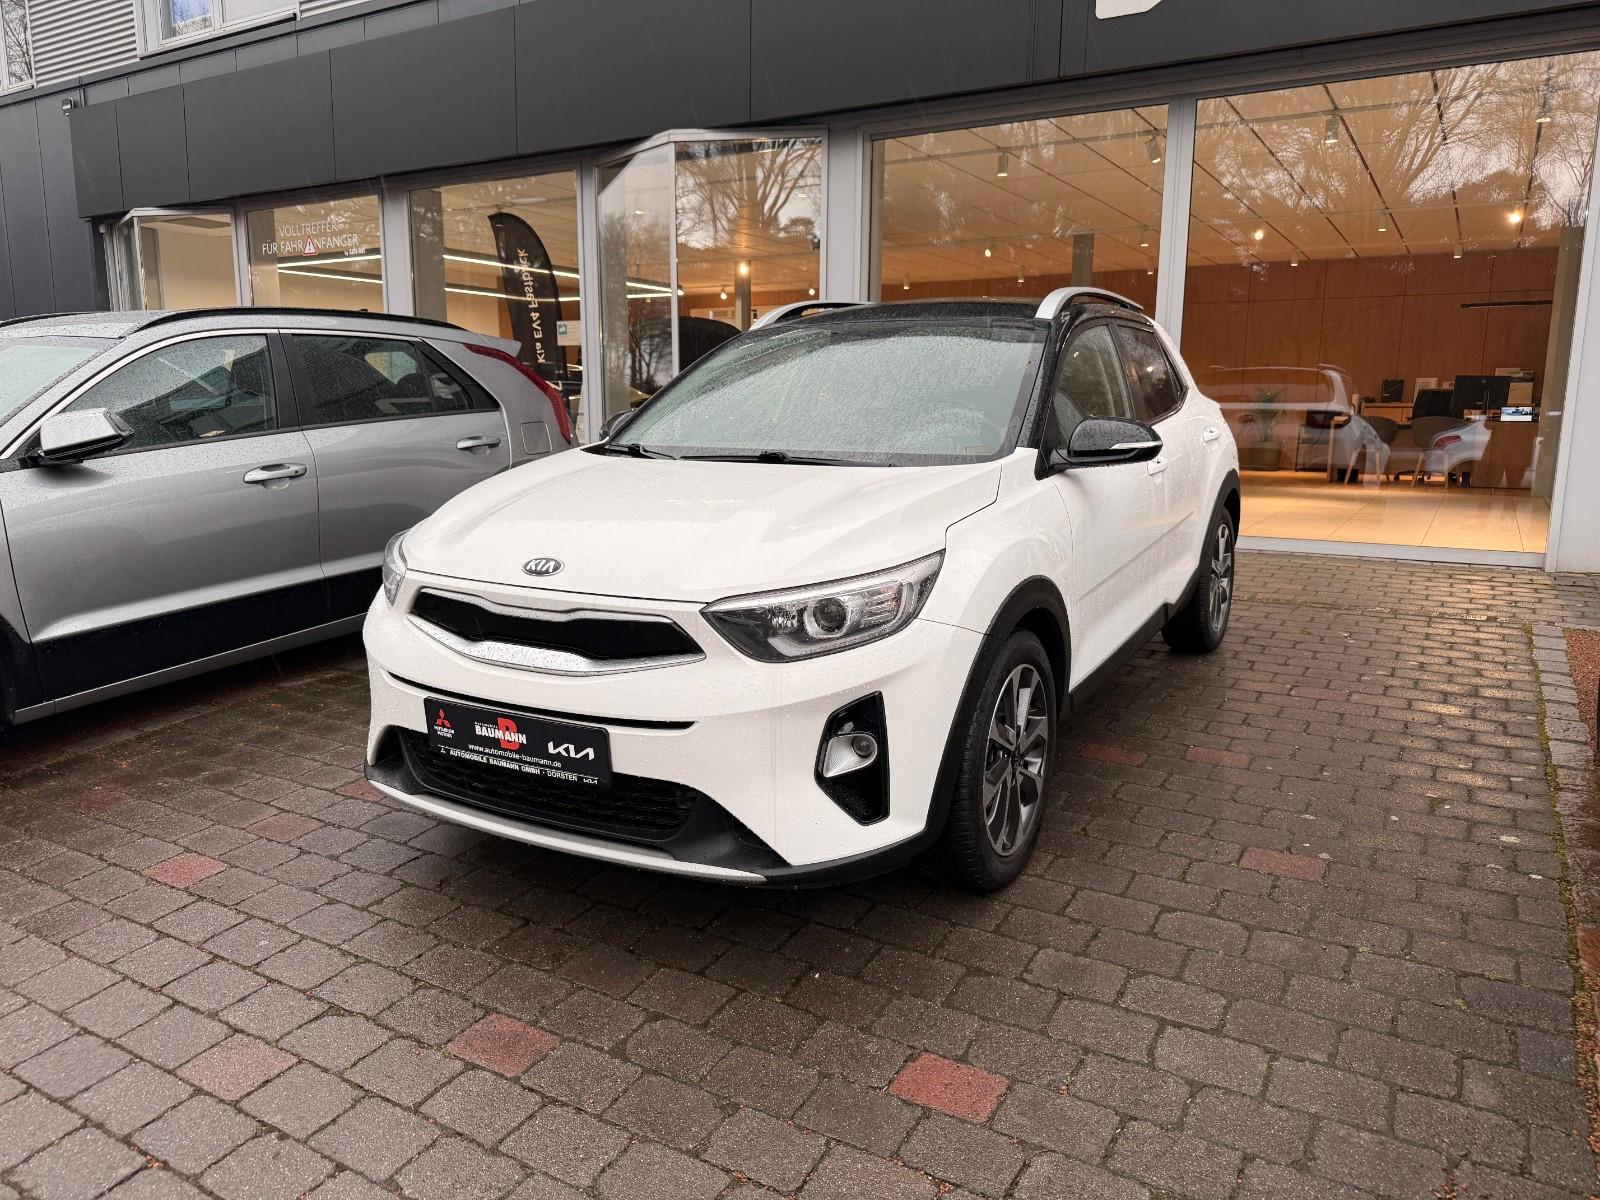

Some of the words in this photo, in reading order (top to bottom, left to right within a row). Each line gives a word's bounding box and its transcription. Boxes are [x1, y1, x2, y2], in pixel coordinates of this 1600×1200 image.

[279, 222, 338, 237] VOLLTREFFER
[262, 239, 279, 255] FÜR
[526, 559, 556, 573] KIA
[474, 724, 527, 745] BAUMANN
[468, 743, 562, 768] www.automobile-baumann.de
[547, 741, 595, 760] KIA
[449, 749, 487, 763] AUTOMOBILE
[489, 756, 519, 771] BAUMANN
[546, 770, 578, 782] DORSTEN
